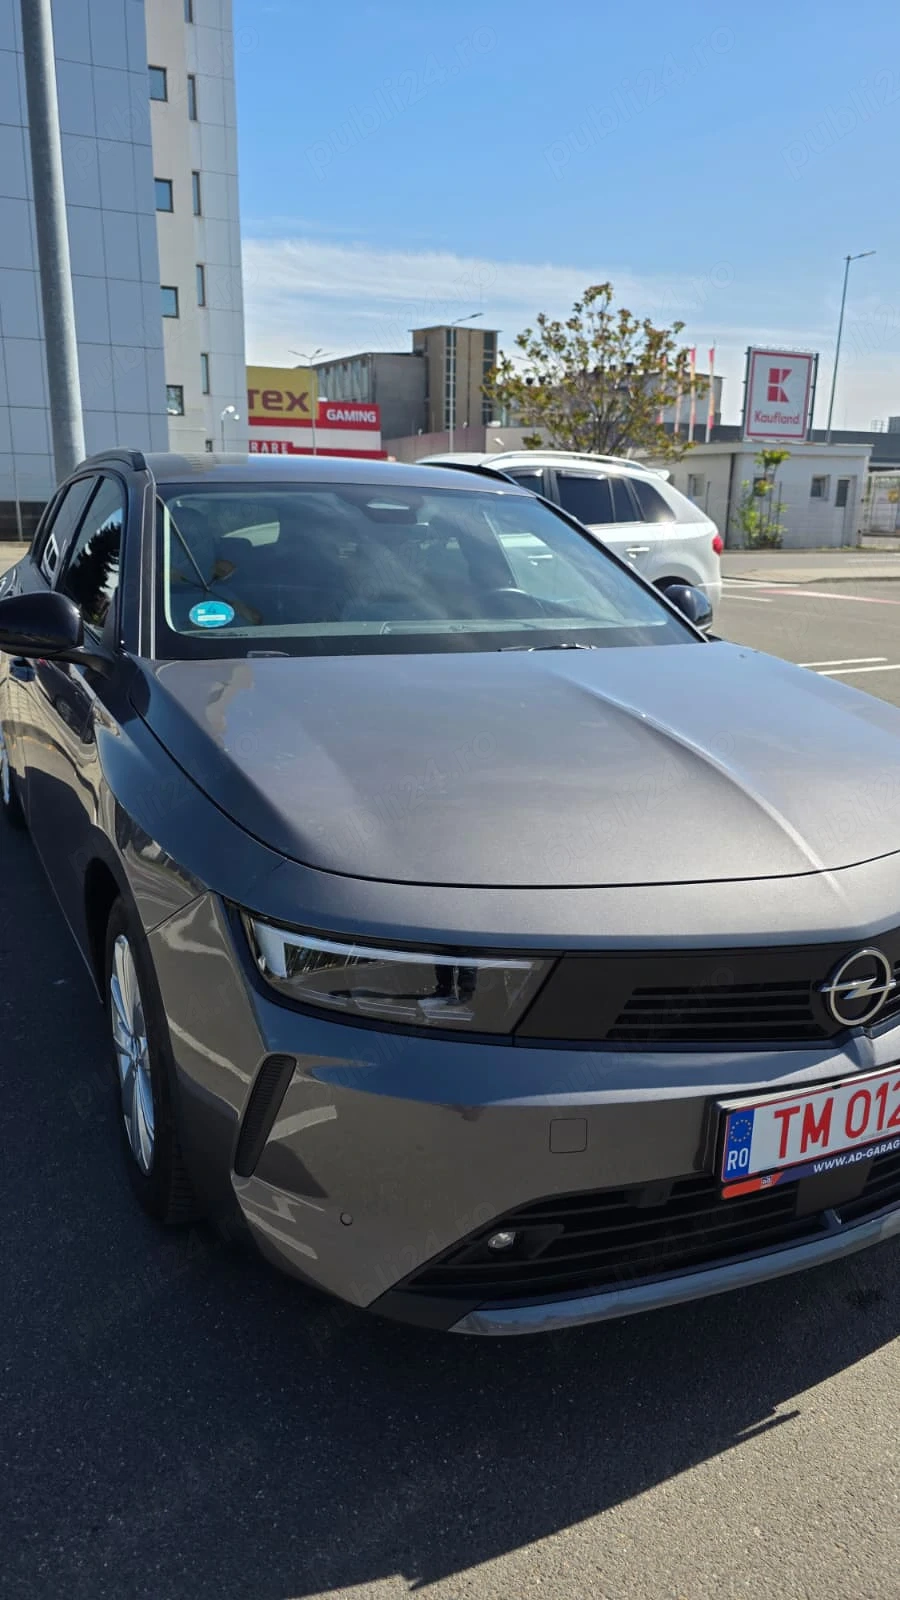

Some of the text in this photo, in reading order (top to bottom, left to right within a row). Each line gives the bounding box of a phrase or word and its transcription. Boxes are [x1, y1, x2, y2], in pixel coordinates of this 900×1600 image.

[326, 409, 376, 423] GAMING
[754, 410, 800, 425] Kaufland
[774, 1097, 834, 1159] TM
[727, 1148, 749, 1171] RO
